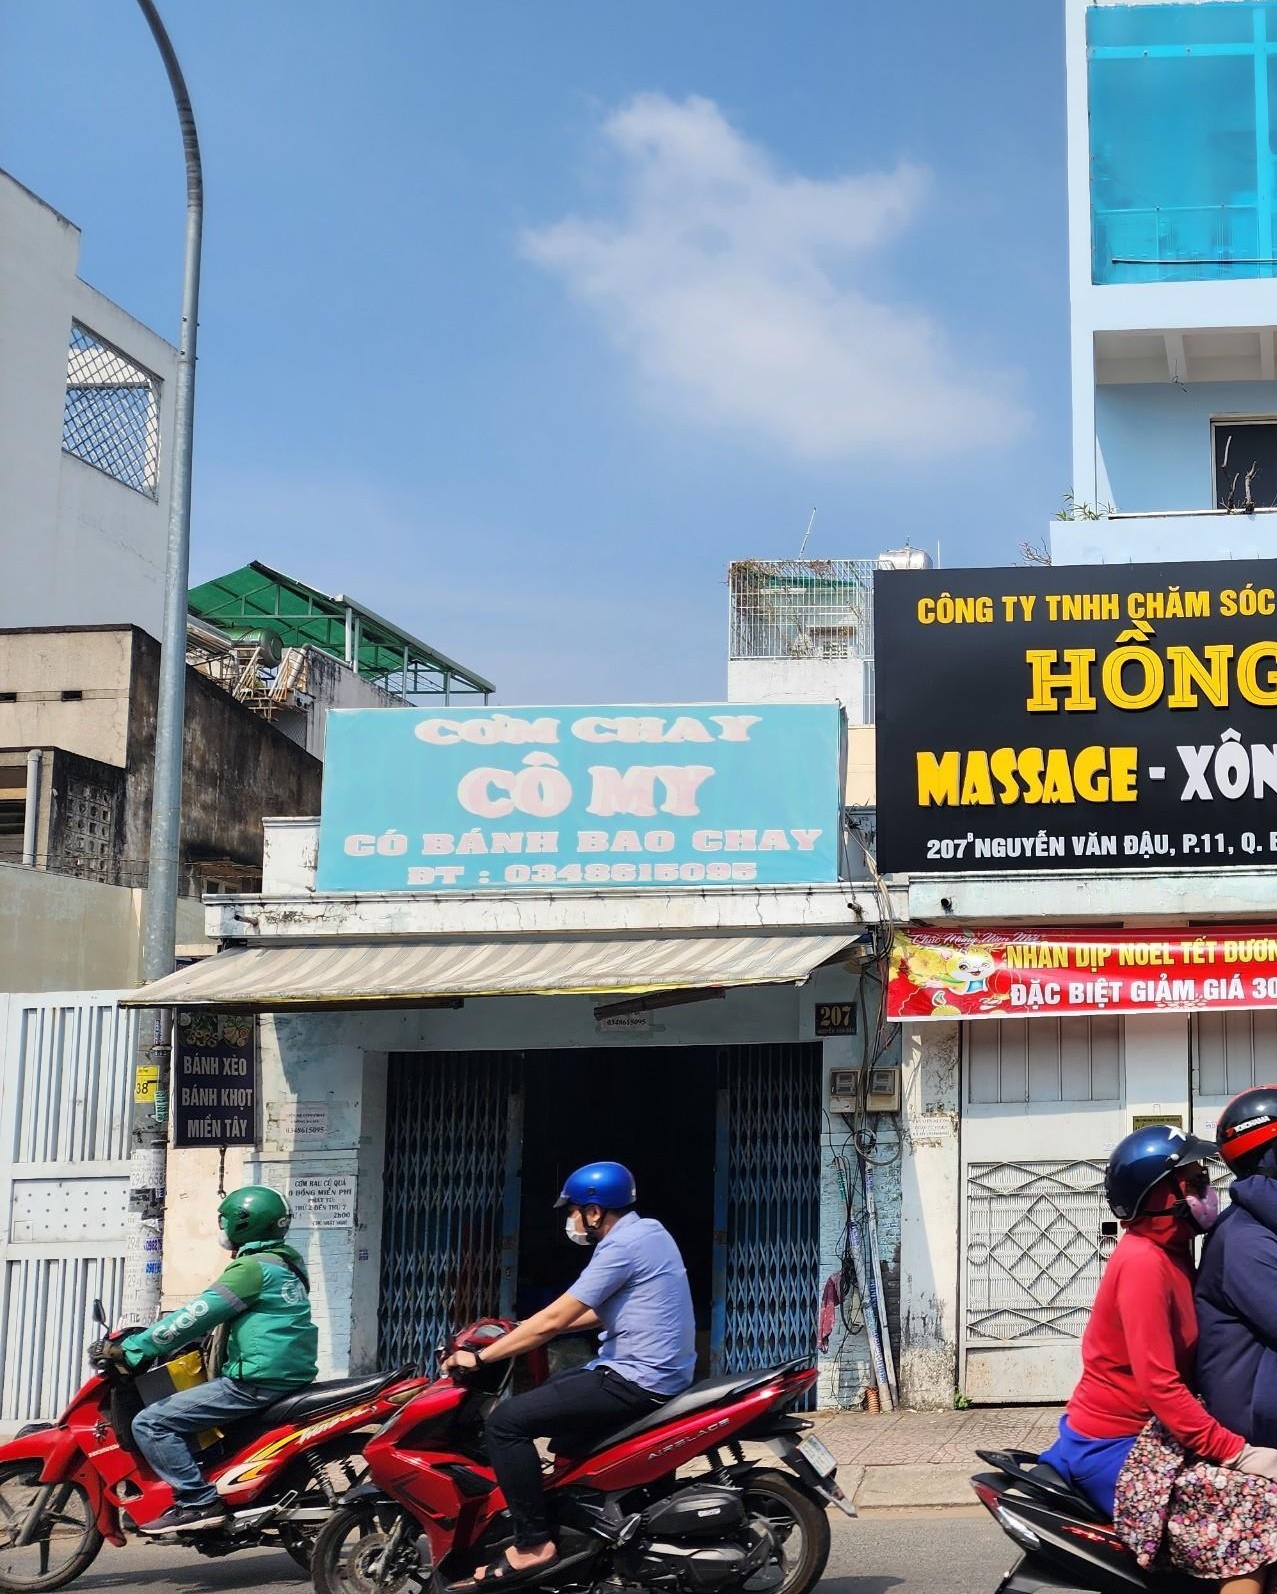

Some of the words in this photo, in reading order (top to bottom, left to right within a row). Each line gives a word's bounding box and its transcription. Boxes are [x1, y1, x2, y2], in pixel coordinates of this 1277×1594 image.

[917, 592, 993, 625] CÔNG
[1002, 595, 1036, 622] TY
[1046, 593, 1120, 620] TNHH
[1127, 585, 1211, 619] CHĂM
[1220, 582, 1275, 617] SÓC
[414, 713, 561, 745] CƠM
[571, 715, 763, 743] CHAY
[457, 751, 573, 819] CÔ
[586, 765, 716, 817] MY
[916, 745, 1139, 807] MASSAGE
[344, 828, 408, 857] CÓ
[422, 827, 559, 855] BÁNH
[577, 830, 675, 852] BAO
[692, 829, 823, 851] CHAY
[974, 830, 1065, 859] NGUYỄN
[1072, 831, 1117, 857] VĂN
[1123, 830, 1175, 860] ĐẬU,
[1241, 831, 1263, 853] Q.
[505, 862, 757, 882] 0348615095
[1076, 943, 1112, 973] DỊP
[1119, 942, 1174, 966] NOEL
[1181, 936, 1217, 964] TẾT
[1010, 979, 1061, 1009] ĐẶC
[1068, 977, 1123, 1008] BIỆT
[1130, 973, 1195, 1003] GIẢM
[1203, 973, 1245, 1000] GIÁ
[820, 1006, 851, 1026] 207
[183, 1053, 219, 1075] BÁNH
[222, 1056, 247, 1075] XÈO
[181, 1085, 217, 1106] BÁNH
[221, 1088, 253, 1111] KHỌT
[187, 1117, 221, 1138] MIỀN
[225, 1119, 248, 1138] TÂY
[151, 1299, 209, 1345] Grab
